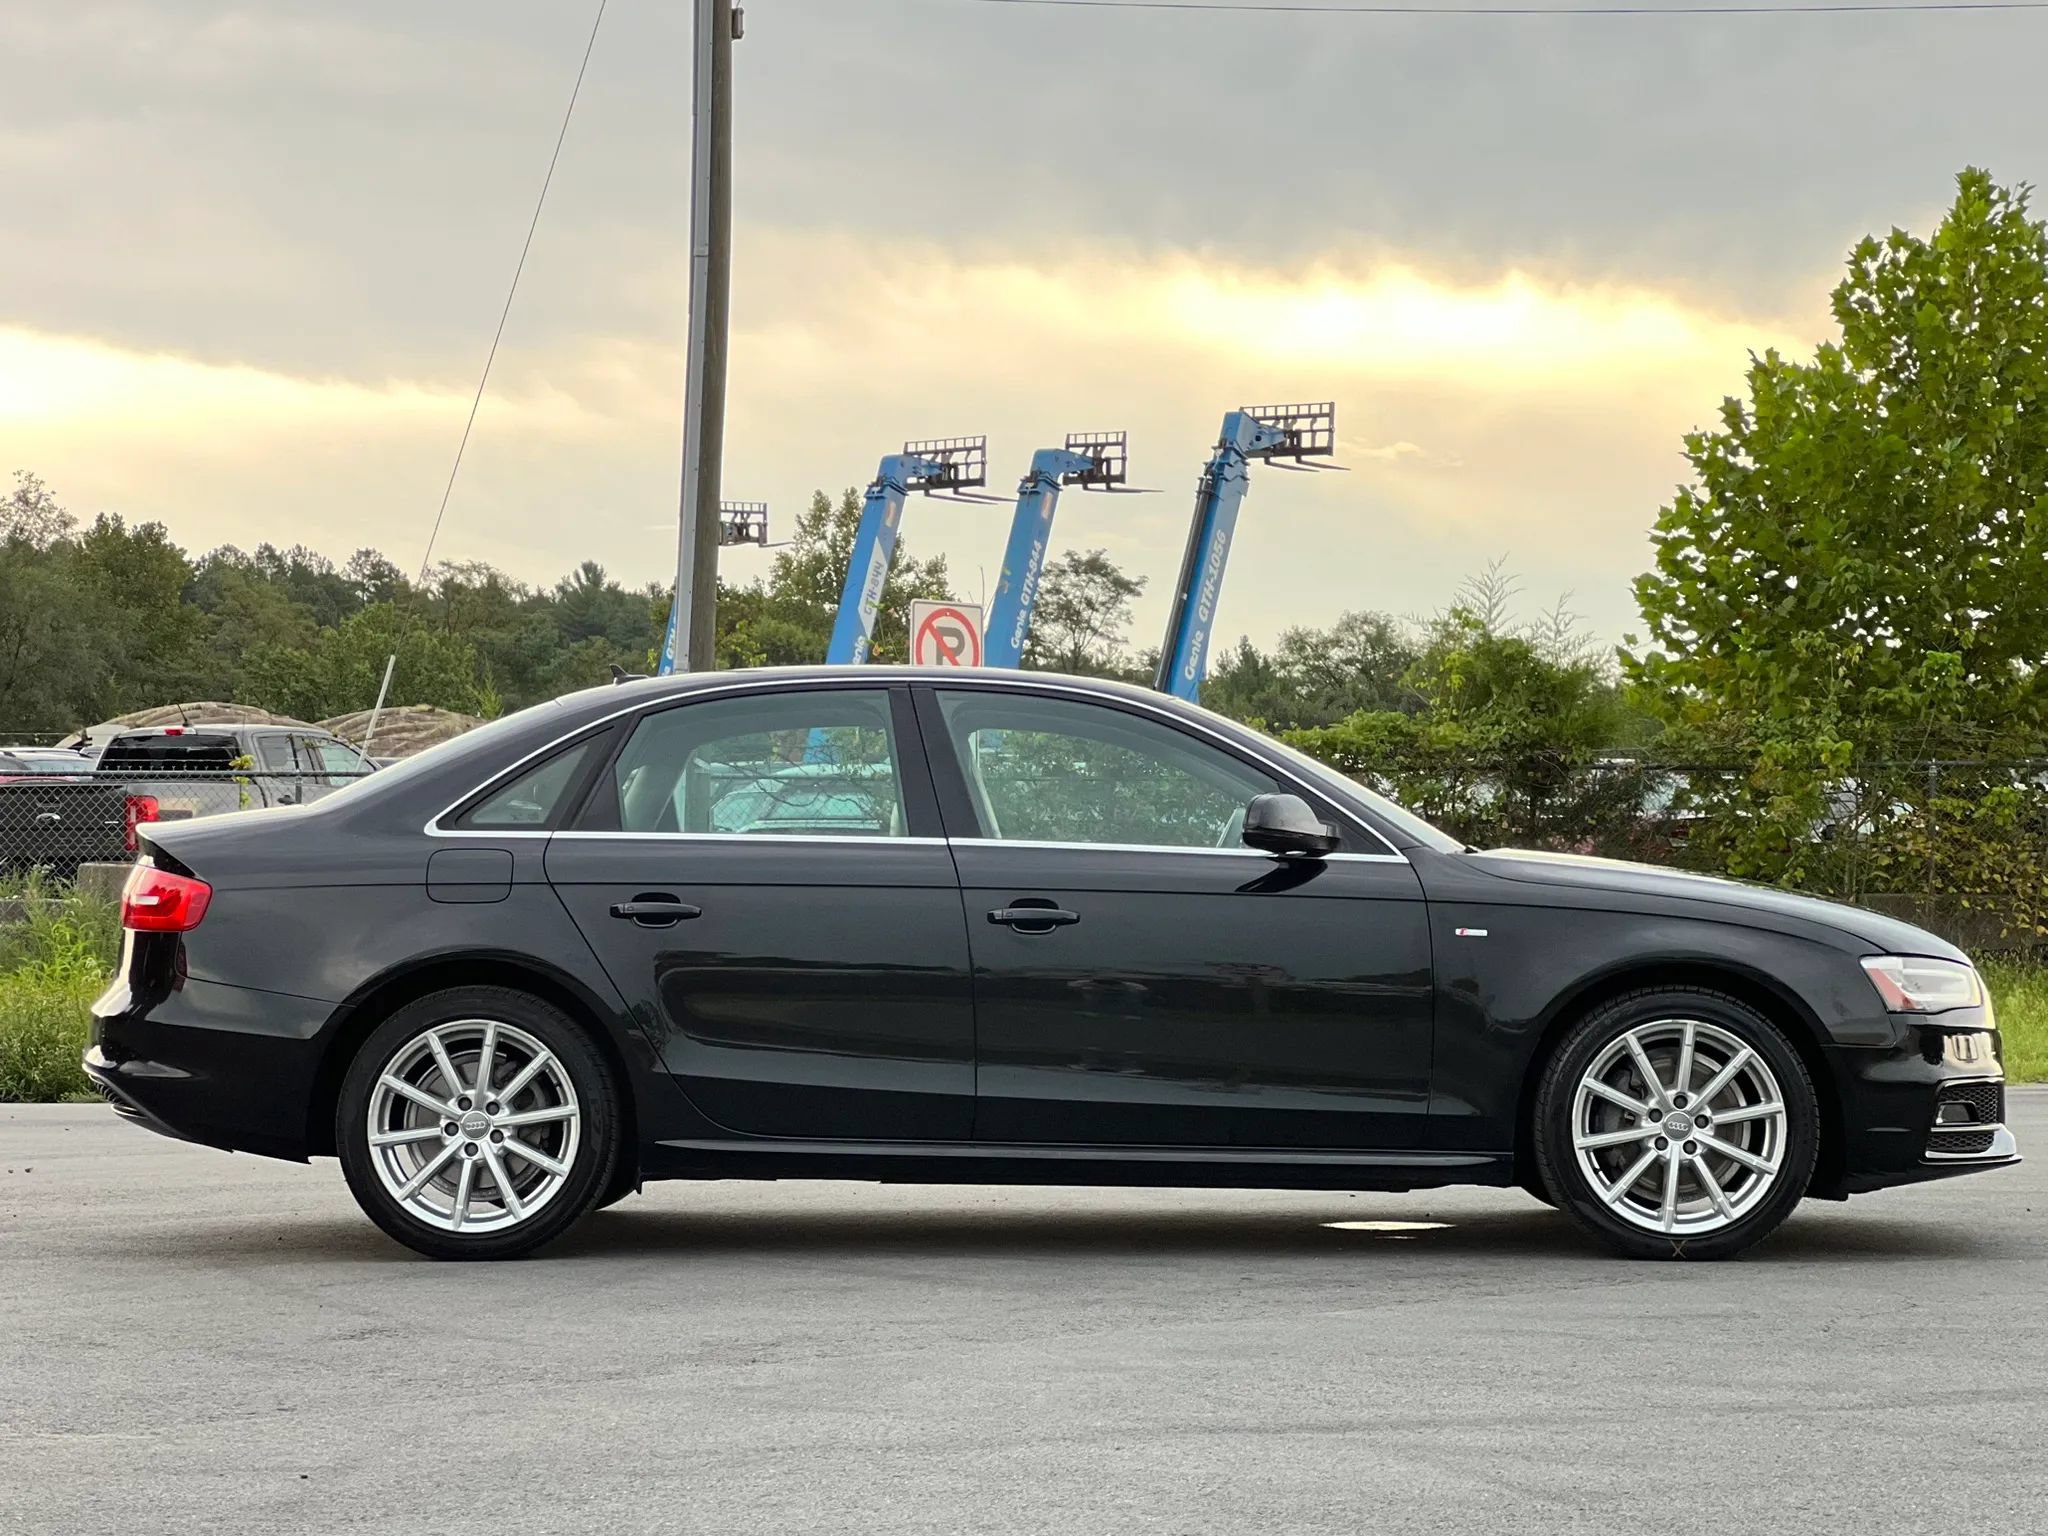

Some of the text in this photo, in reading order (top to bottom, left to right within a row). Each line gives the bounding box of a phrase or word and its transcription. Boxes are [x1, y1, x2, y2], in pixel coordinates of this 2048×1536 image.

[1011, 539, 1042, 649] Genie GTH-844
[1184, 529, 1226, 680] Genie GTH-1056
[852, 635, 866, 665] enie
